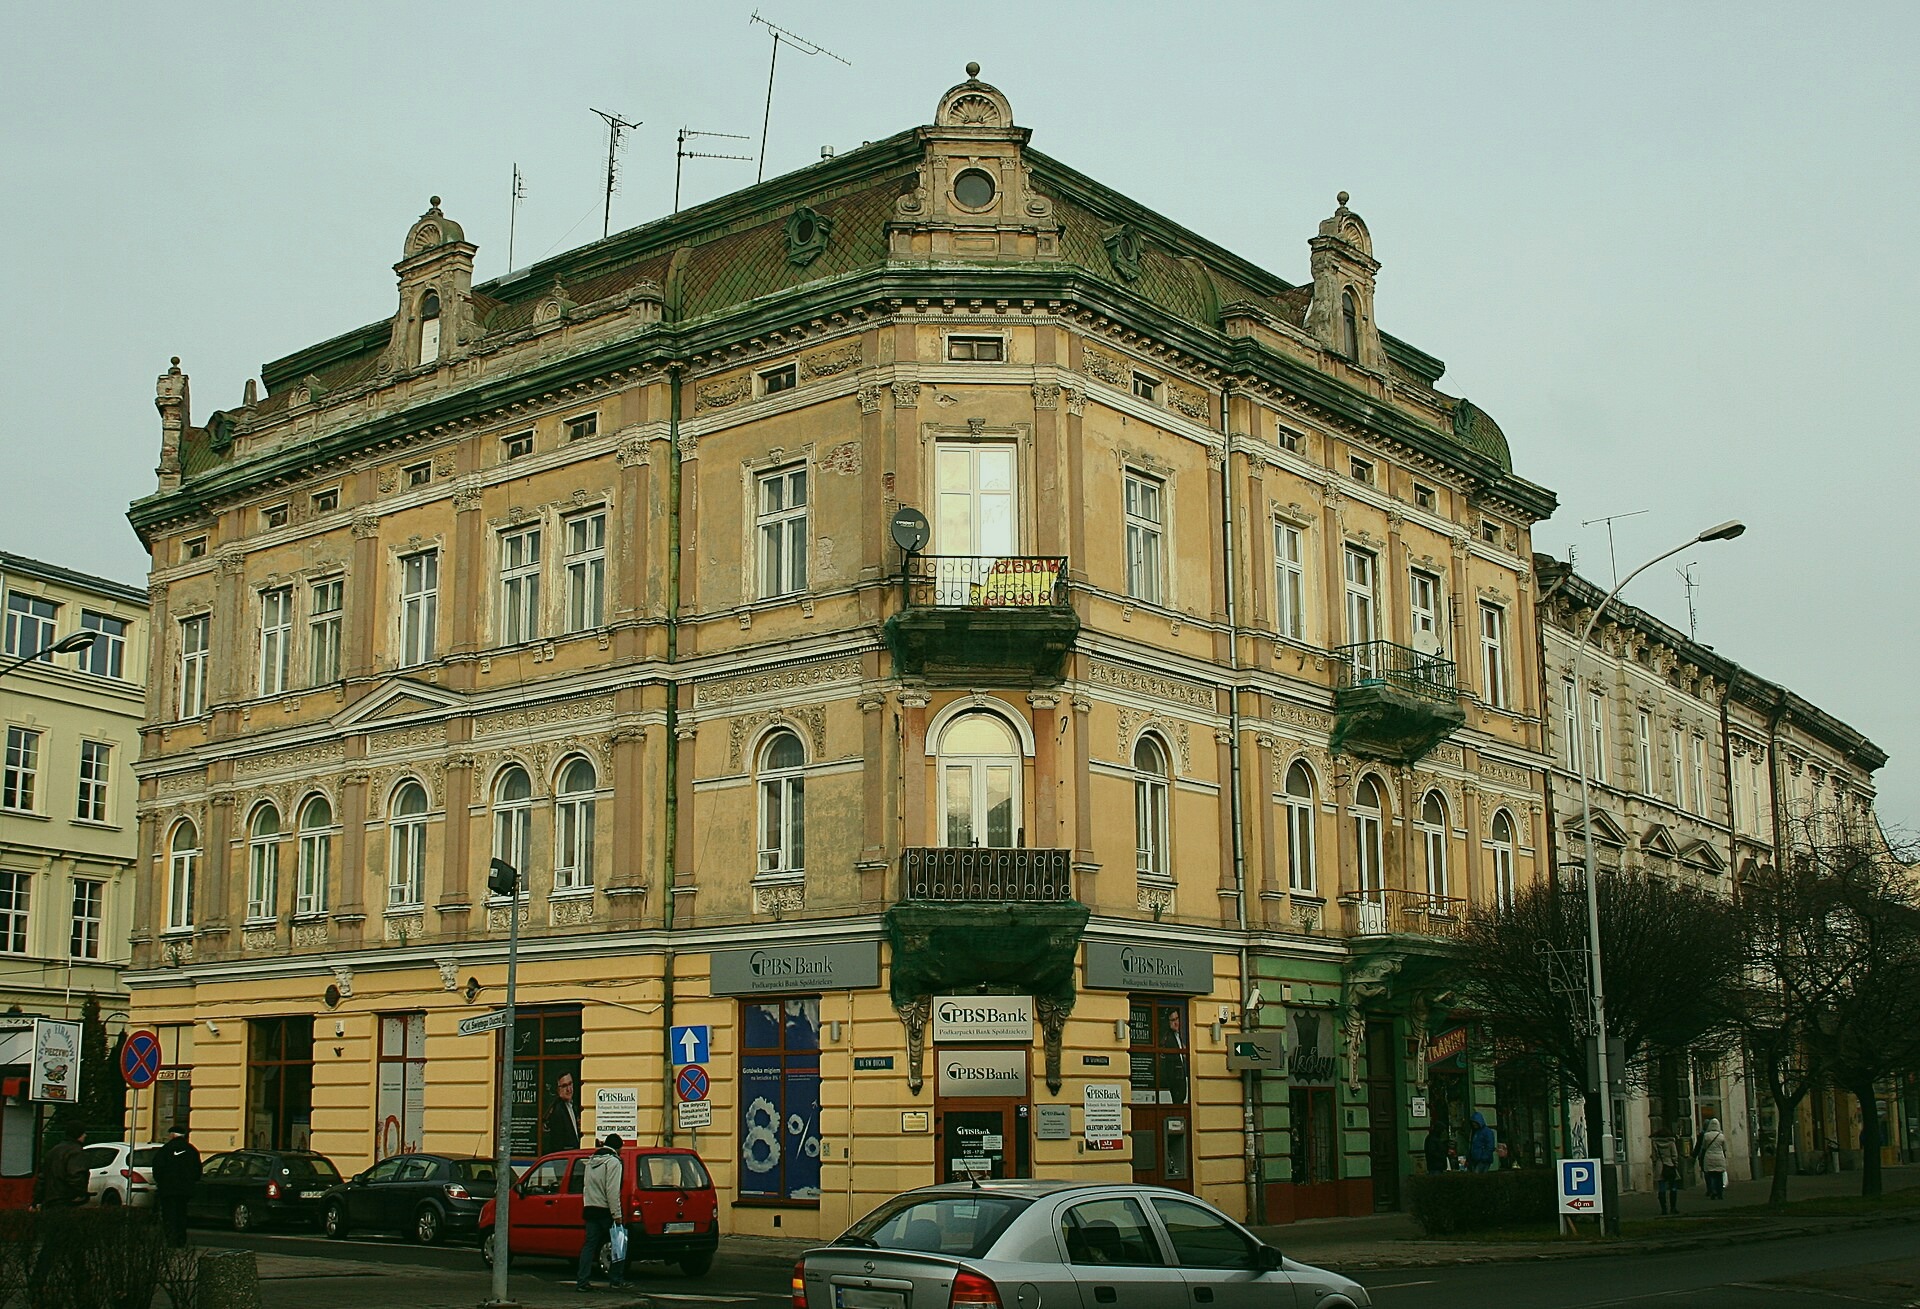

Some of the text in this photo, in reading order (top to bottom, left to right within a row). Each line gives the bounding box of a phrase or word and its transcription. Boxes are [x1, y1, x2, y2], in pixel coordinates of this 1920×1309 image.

[795, 955, 833, 974] Bank
[1156, 958, 1184, 976] Bank
[1571, 1167, 1589, 1190] P
